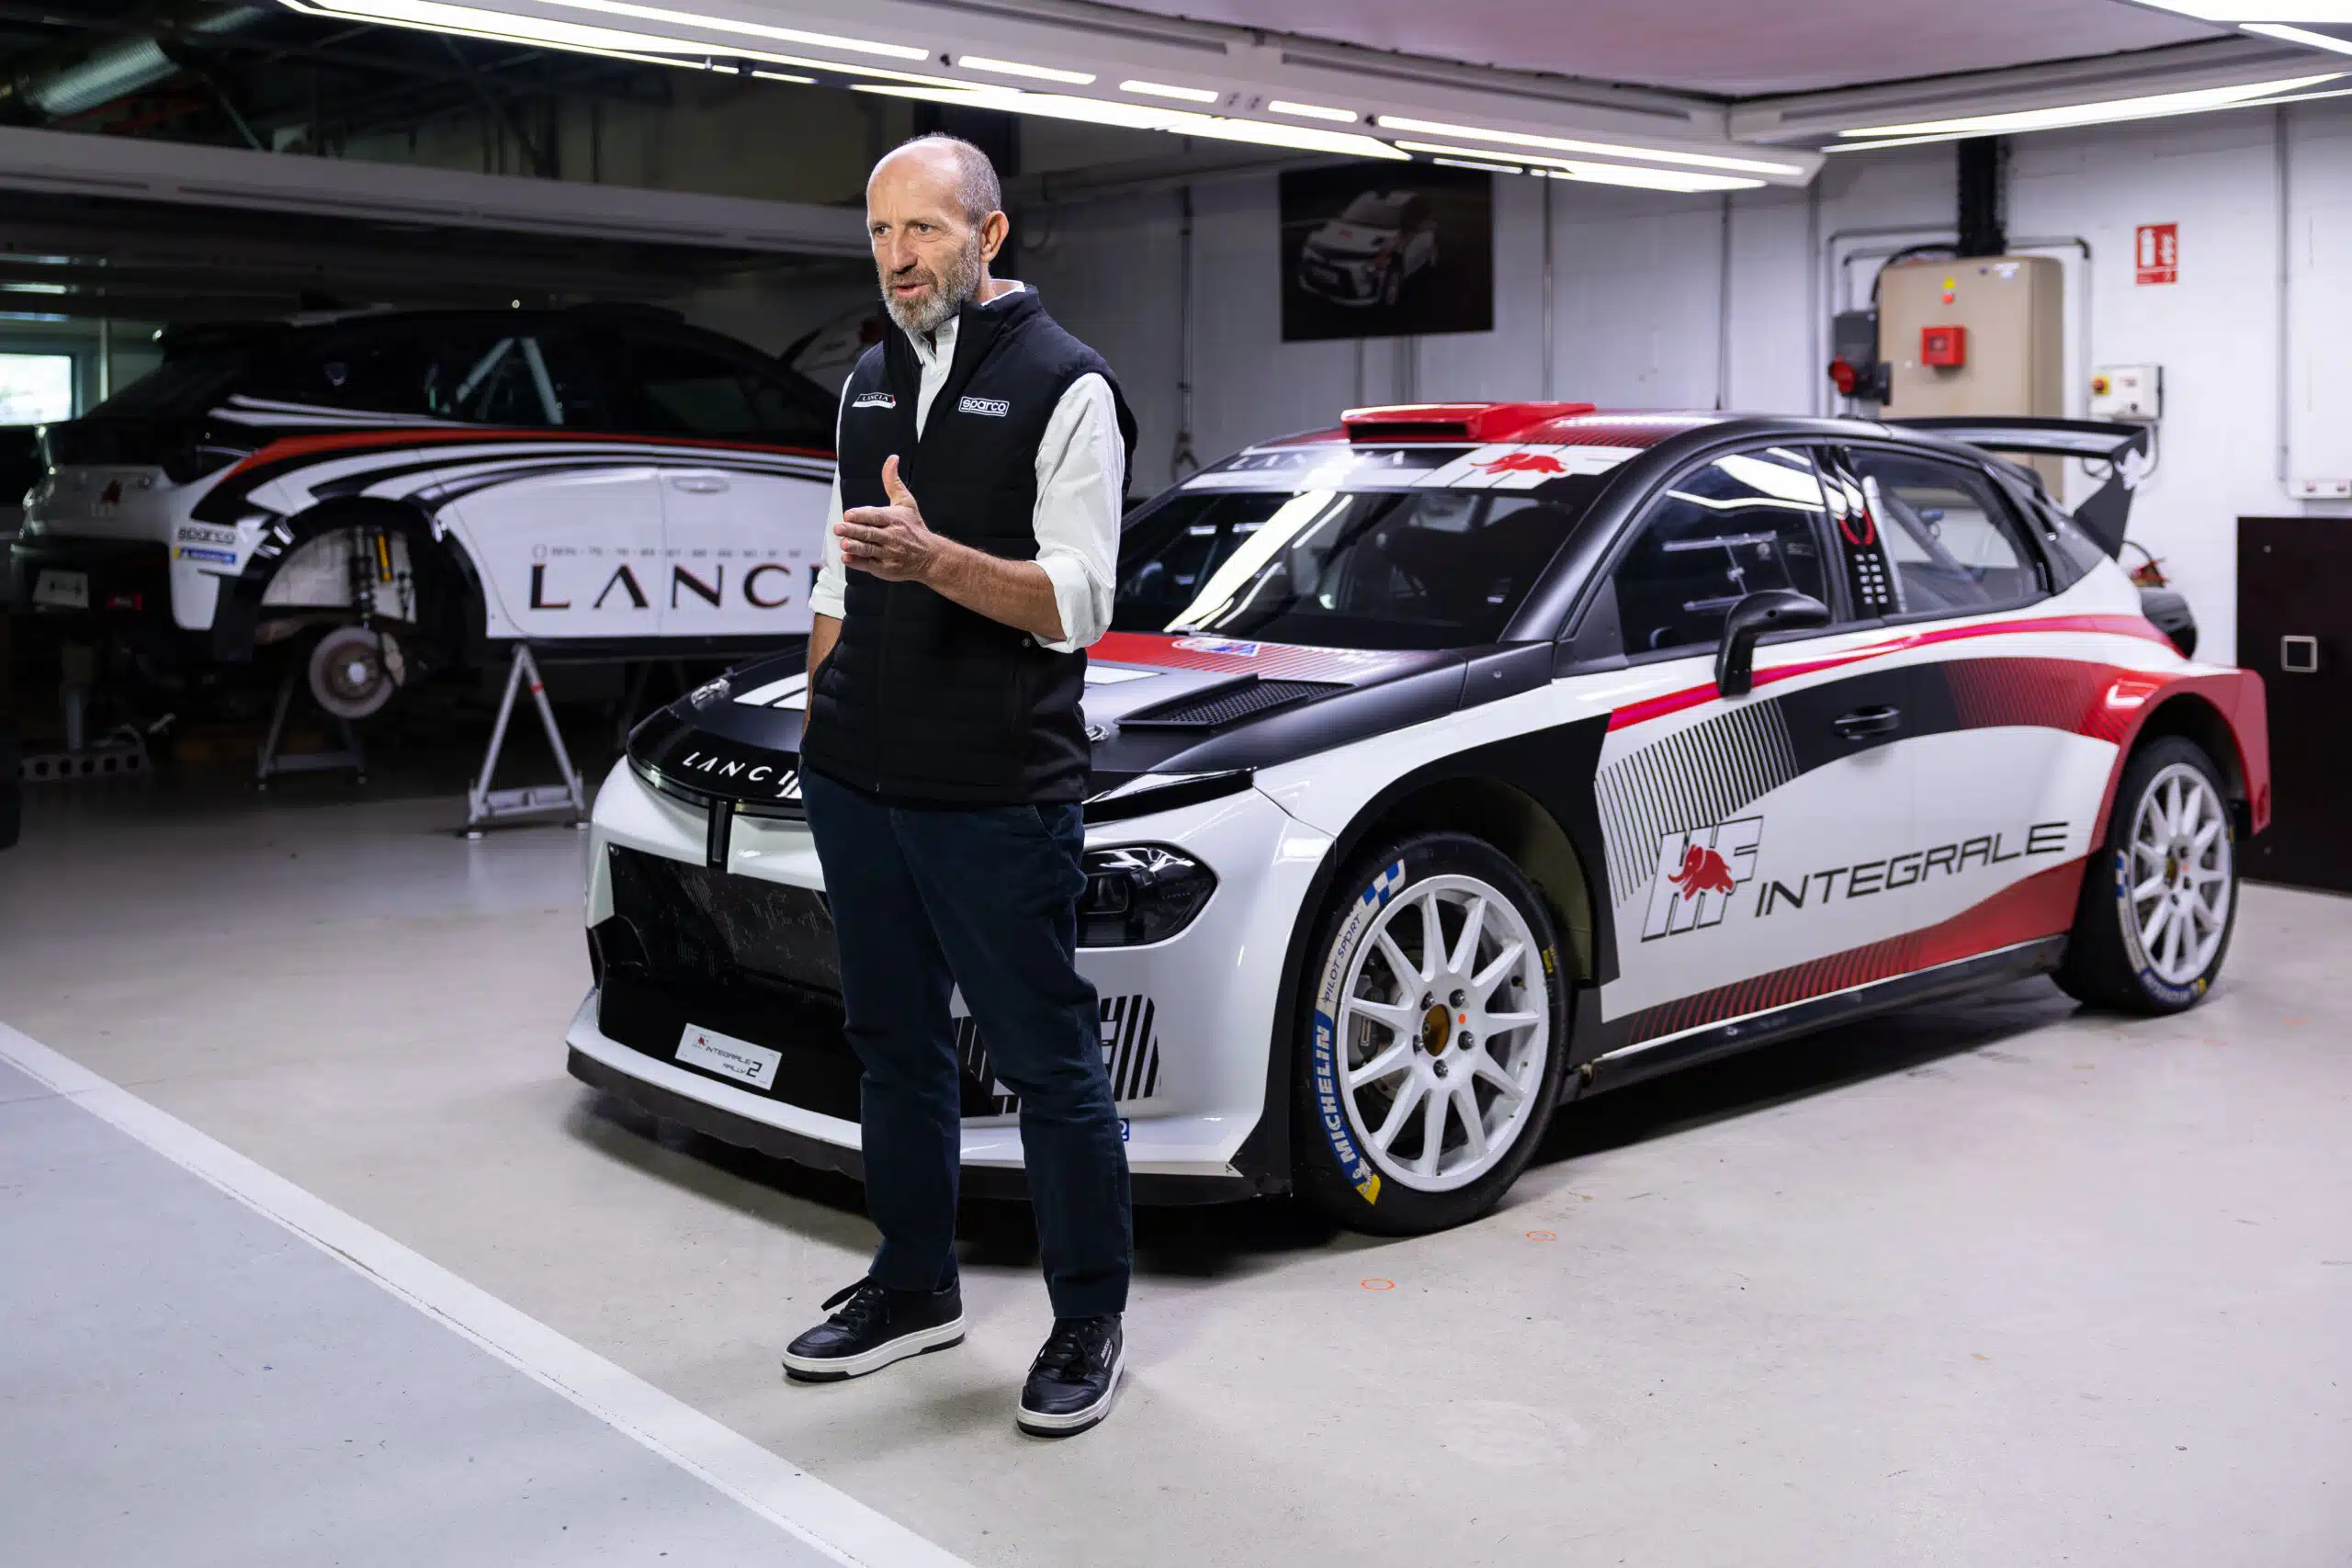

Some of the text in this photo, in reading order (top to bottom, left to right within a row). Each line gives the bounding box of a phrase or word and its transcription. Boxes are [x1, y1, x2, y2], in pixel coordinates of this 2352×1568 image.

[962, 399, 1007, 412] sparco
[1755, 822, 2070, 918] INTEGRALE
[1324, 913, 1362, 1003] PILOT SPORT
[746, 1061, 763, 1078] 2
[1317, 1024, 1357, 1164] MICHELIN
